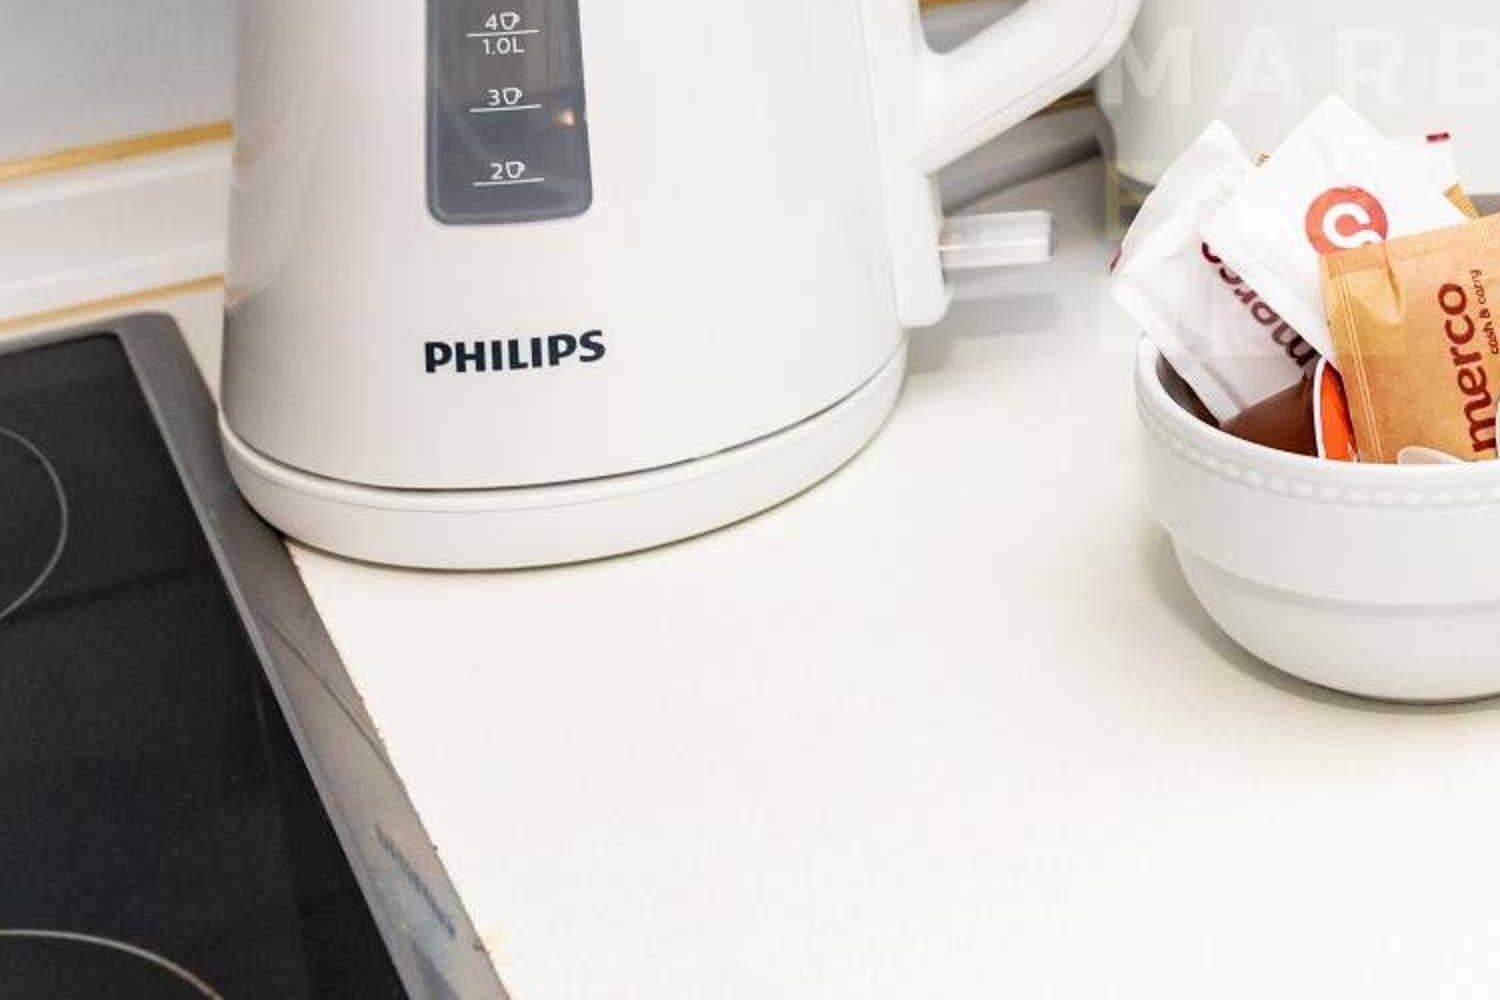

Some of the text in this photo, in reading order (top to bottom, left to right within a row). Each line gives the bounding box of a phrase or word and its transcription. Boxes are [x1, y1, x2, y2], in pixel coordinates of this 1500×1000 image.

[485, 13, 498, 31] 4
[482, 36, 526, 55] 1.0L
[487, 89, 501, 106] 3
[489, 162, 503, 180] 2
[424, 329, 607, 373] PHILIPS
[1437, 282, 1497, 453] merco
